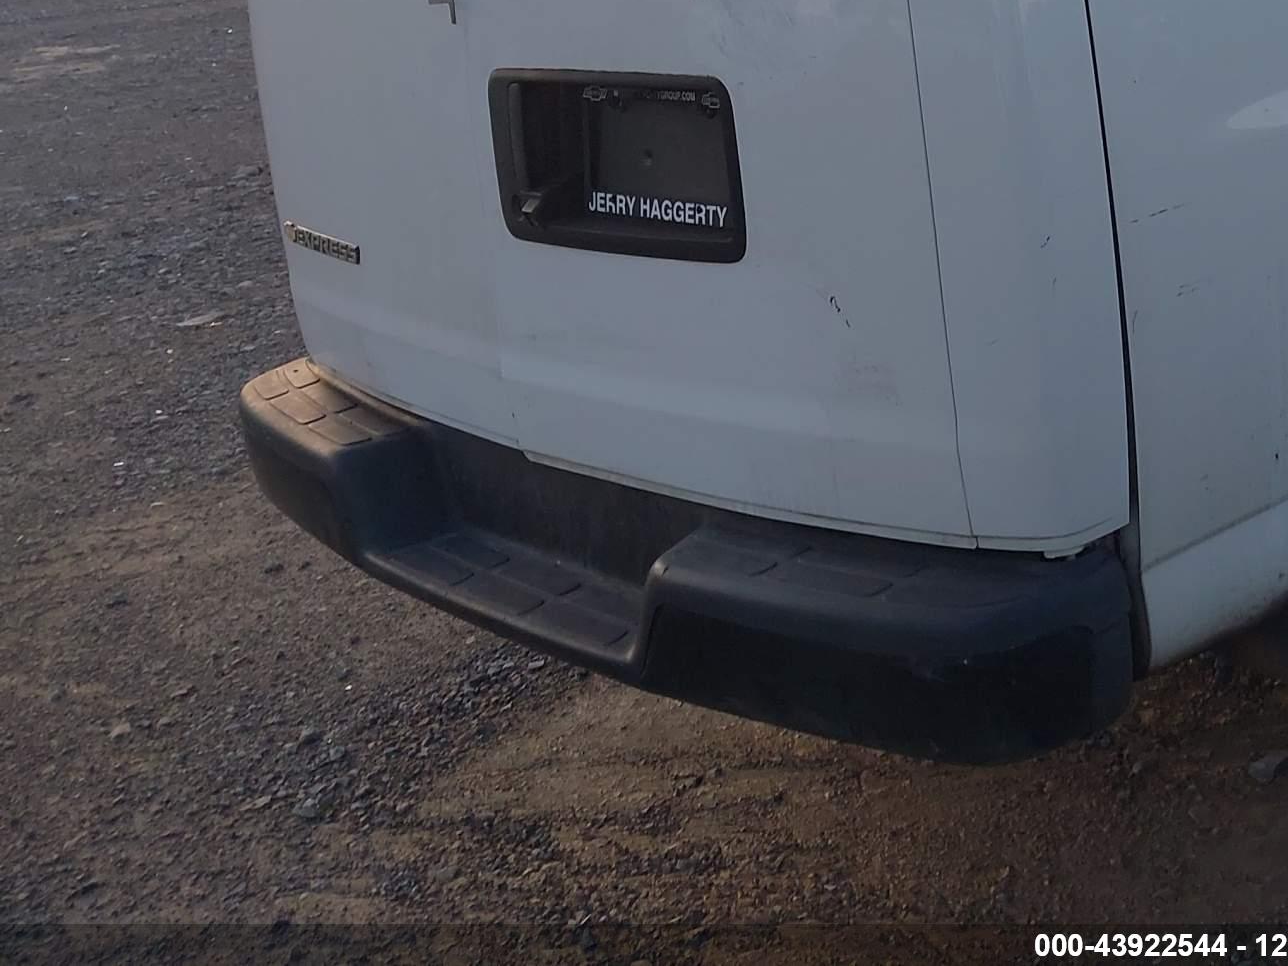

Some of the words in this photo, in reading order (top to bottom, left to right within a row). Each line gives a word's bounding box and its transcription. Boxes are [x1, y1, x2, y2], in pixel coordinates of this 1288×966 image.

[588, 191, 637, 218] JERRY
[640, 197, 728, 228] HAGGERTY
[297, 228, 358, 264] EXPRESS
